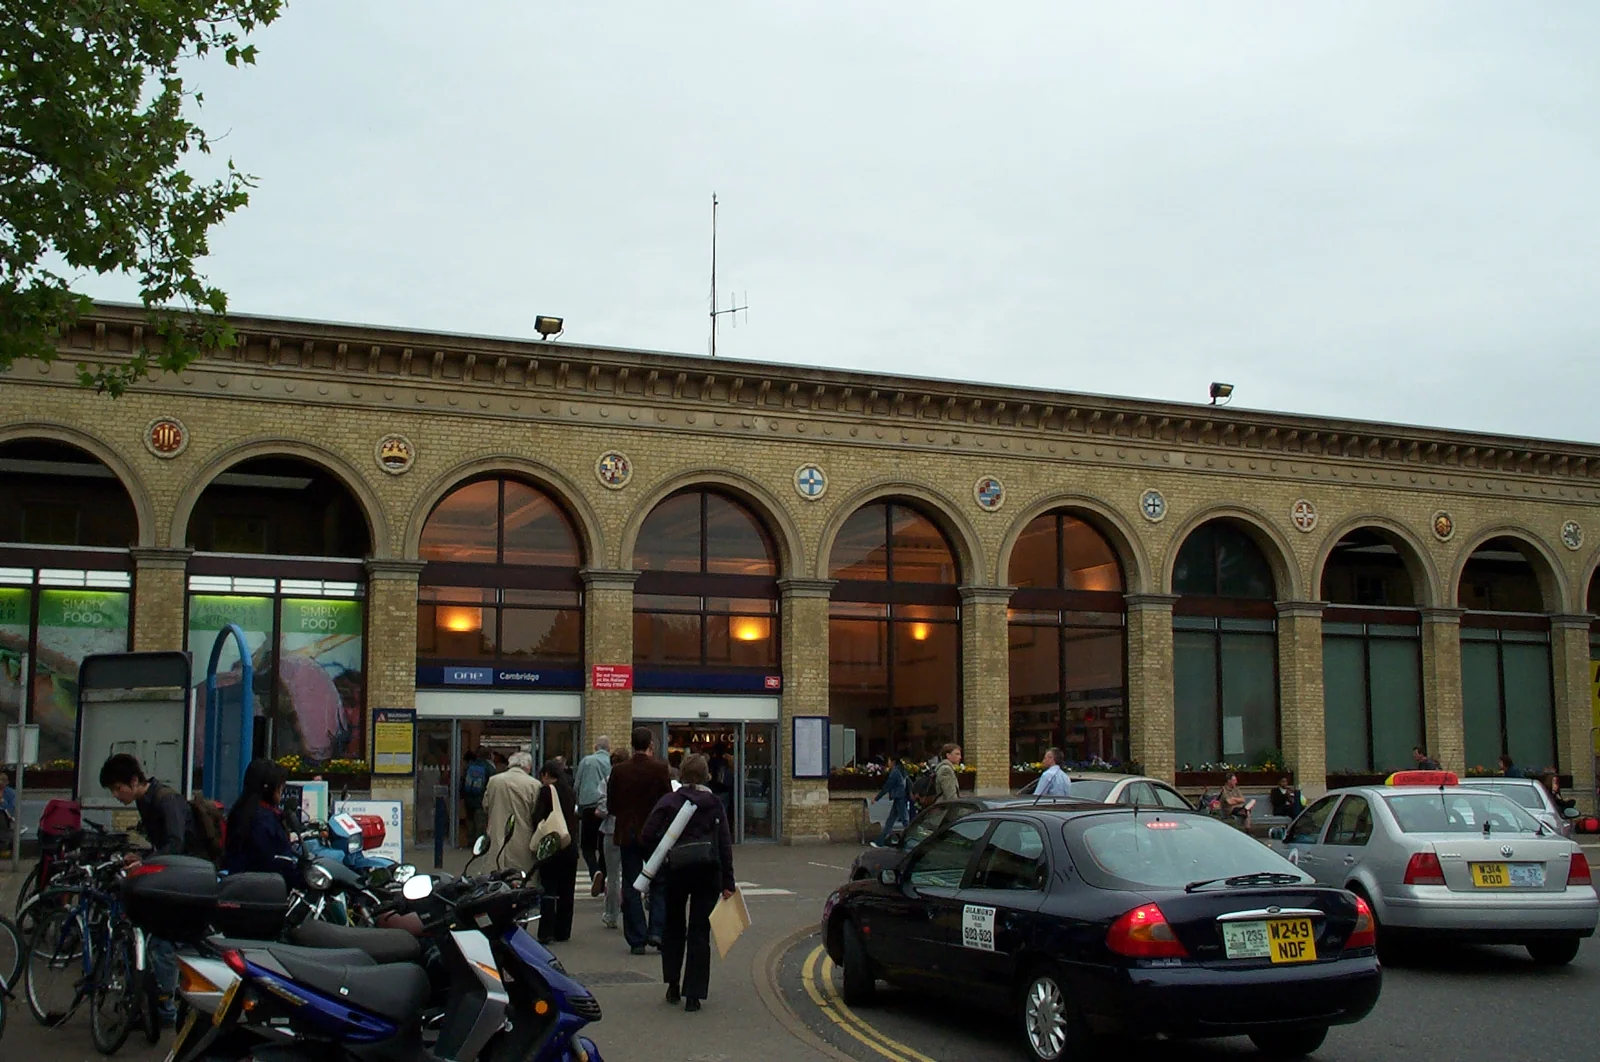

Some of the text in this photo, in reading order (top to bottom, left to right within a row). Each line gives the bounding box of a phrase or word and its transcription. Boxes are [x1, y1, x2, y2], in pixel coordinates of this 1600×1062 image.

[62, 599, 105, 610] SIMPLY
[300, 606, 339, 617] SIMPLY
[63, 612, 103, 624] FOOD
[301, 618, 337, 630] FOOD
[454, 671, 483, 681] one
[499, 672, 540, 682] Cambridge
[965, 906, 994, 916] DIAMOND
[1241, 929, 1264, 942] 1235
[1270, 921, 1309, 940] W249
[1278, 941, 1306, 958] NDF
